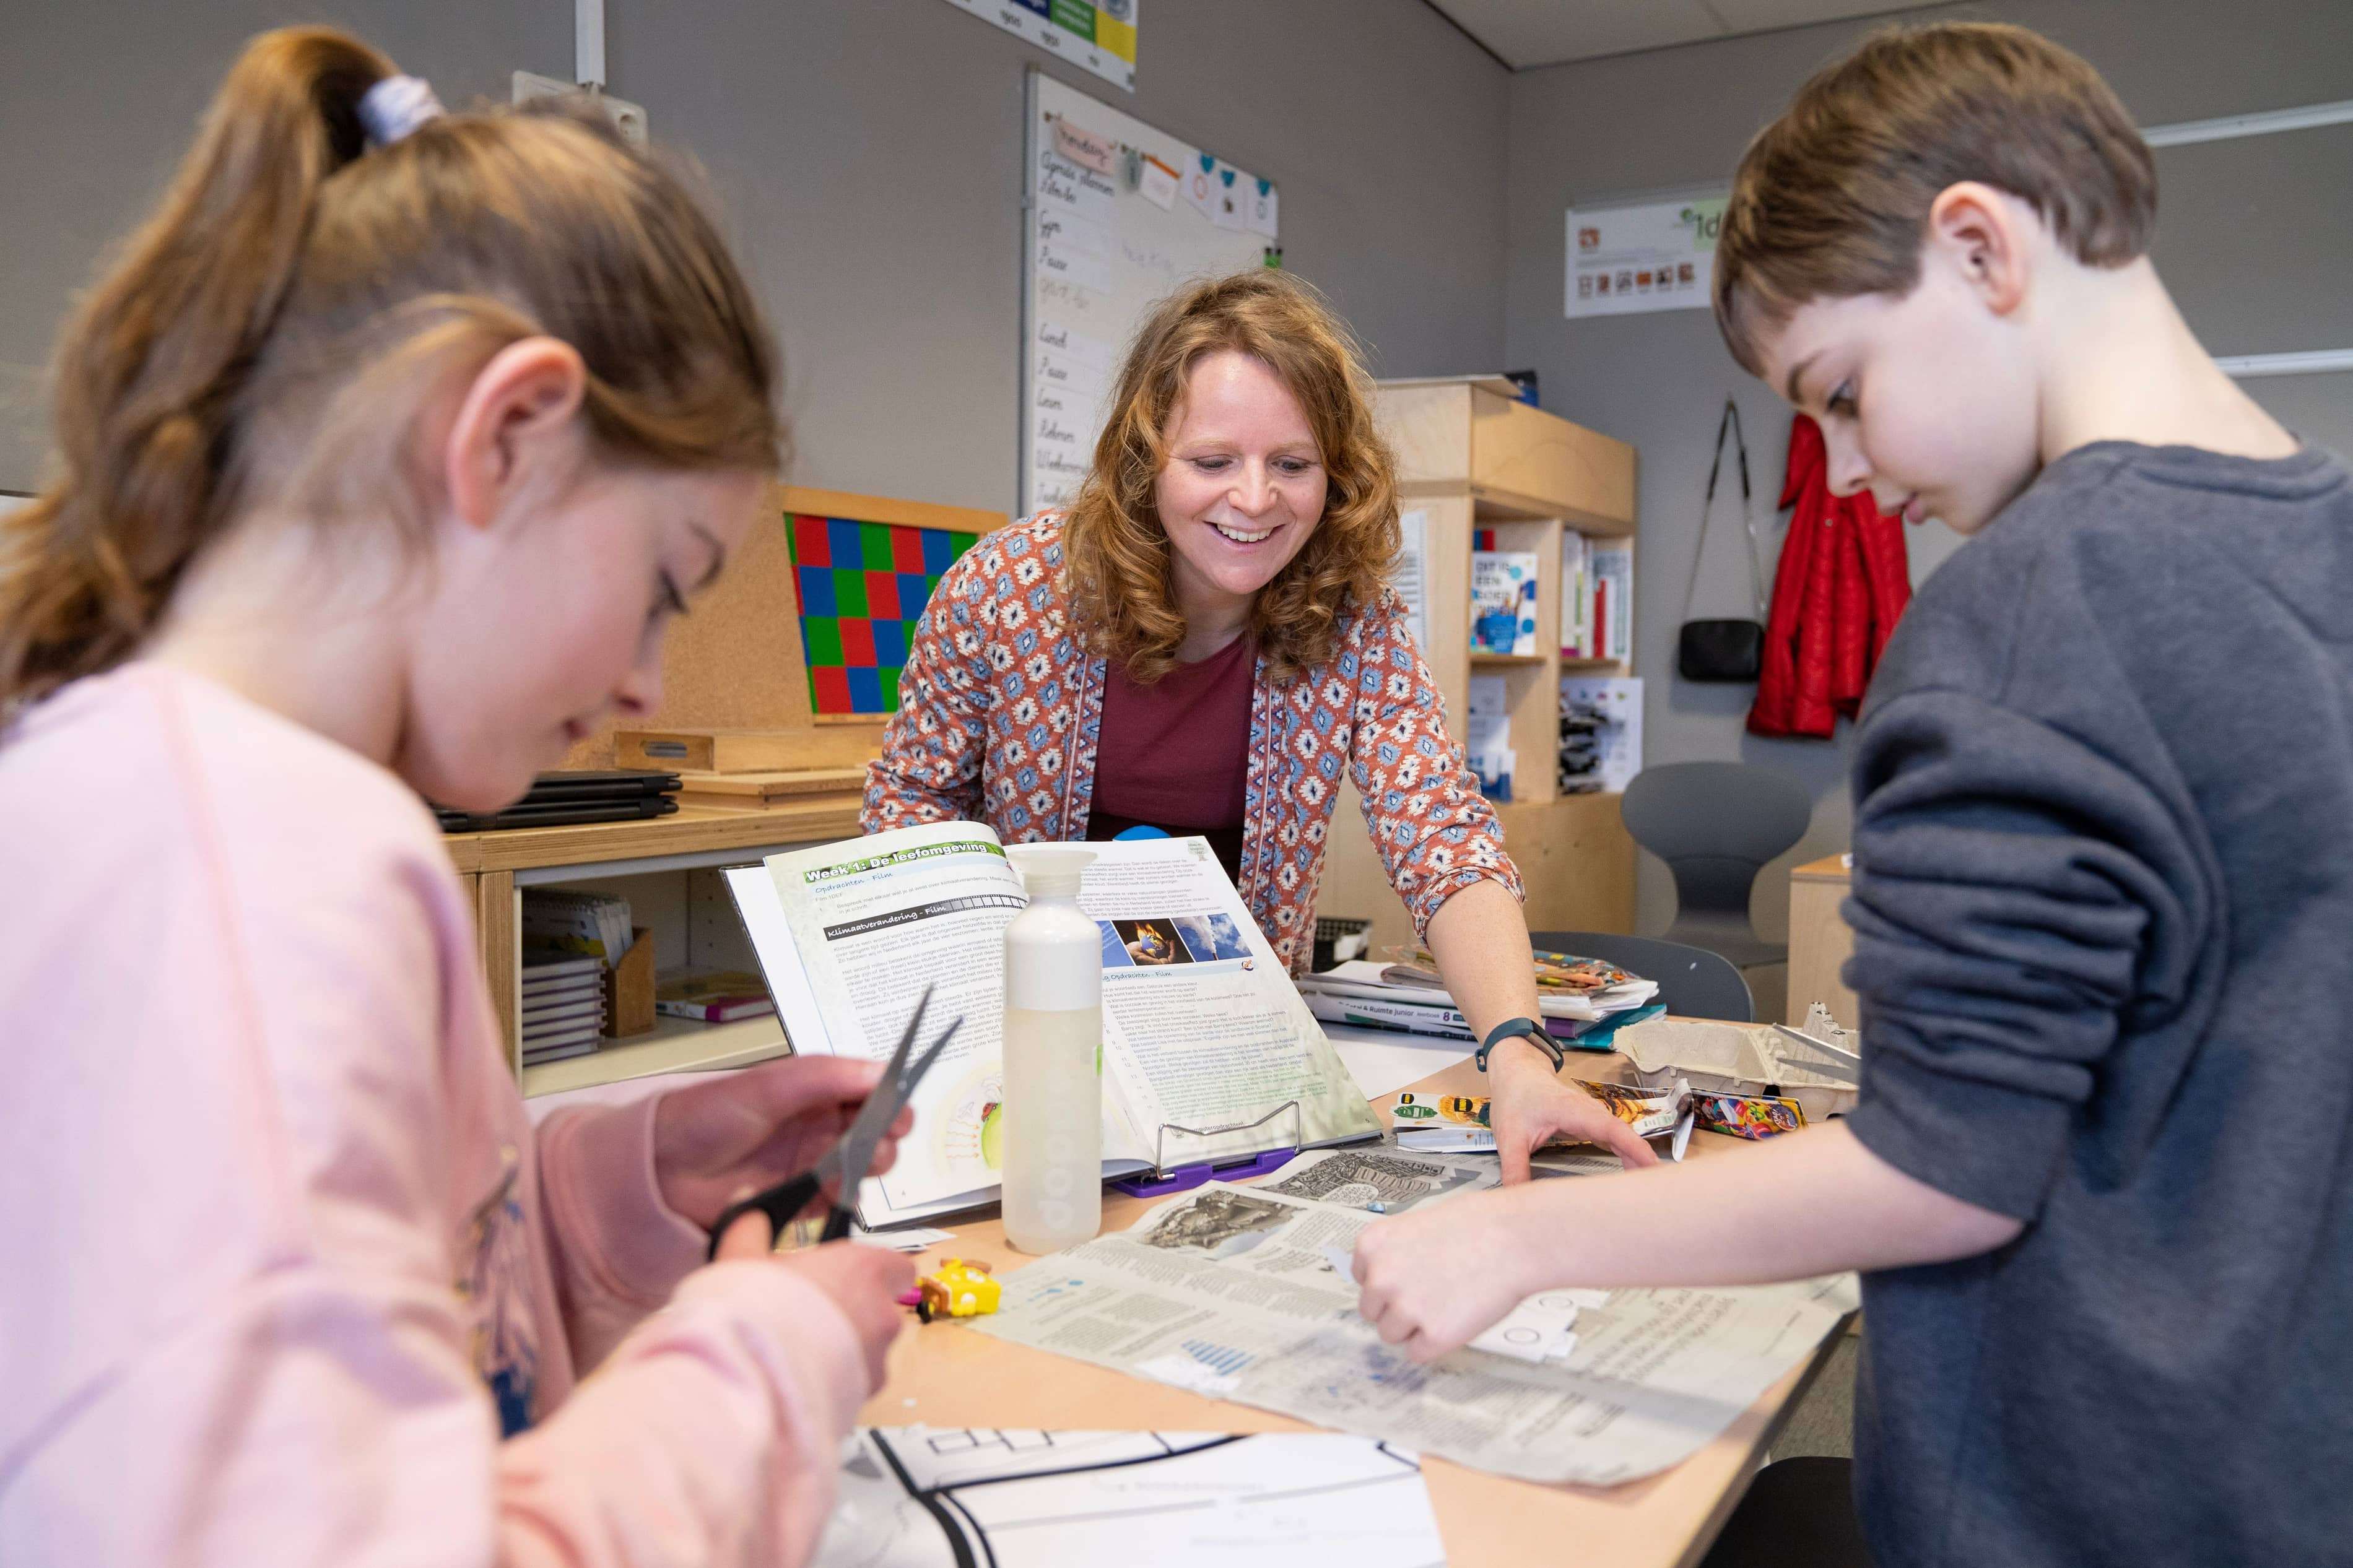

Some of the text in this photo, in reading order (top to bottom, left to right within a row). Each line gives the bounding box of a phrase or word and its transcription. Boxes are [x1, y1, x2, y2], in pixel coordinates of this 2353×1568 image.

[806, 842, 988, 883] Week 1: De leefomgeving
[815, 878, 864, 894] Opdrachten
[872, 872, 894, 881] Film
[837, 899, 861, 908] Bespreek
[828, 912, 918, 938] Klimaatverandering
[925, 905, 947, 916] Film
[883, 942, 911, 952] Nederland
[888, 955, 911, 964] betekent
[1111, 972, 1150, 981] Opdrachten
[1369, 1005, 1393, 1014] Ruimte
[1443, 1011, 1450, 1021] 8
